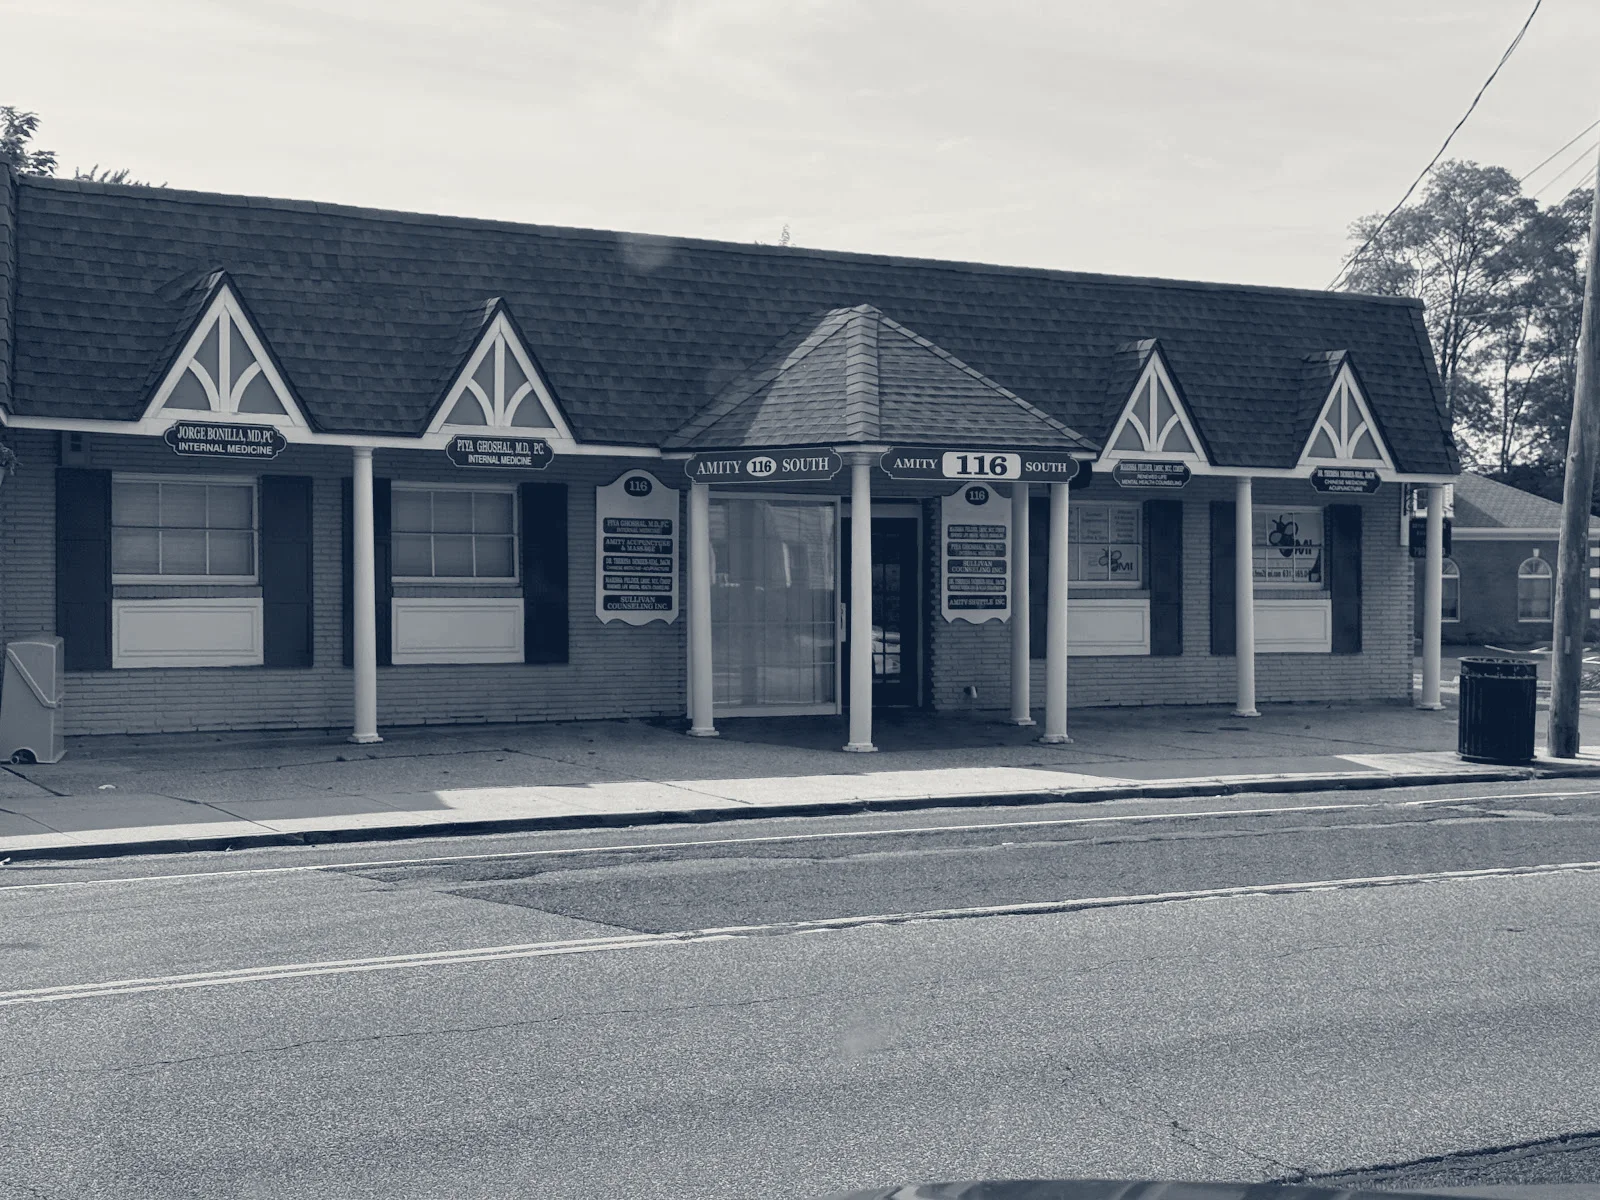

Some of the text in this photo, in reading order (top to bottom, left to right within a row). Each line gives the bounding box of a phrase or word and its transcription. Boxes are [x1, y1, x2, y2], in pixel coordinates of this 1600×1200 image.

[177, 426, 206, 440] JORGE
[207, 427, 246, 443] BONILLA,
[179, 442, 272, 454] INTERNAL MEDICINE
[457, 440, 474, 451] PIYA
[476, 440, 514, 455] GHOSHAL,
[468, 454, 532, 465] INTERNAL MEDICINE
[894, 455, 1067, 476] AMITY 116 SOUTH
[696, 457, 829, 475] AMITY 116 SOUTH
[629, 481, 648, 491] 116
[969, 491, 986, 500] 116
[627, 539, 671, 547] ACUPUNCTURE
